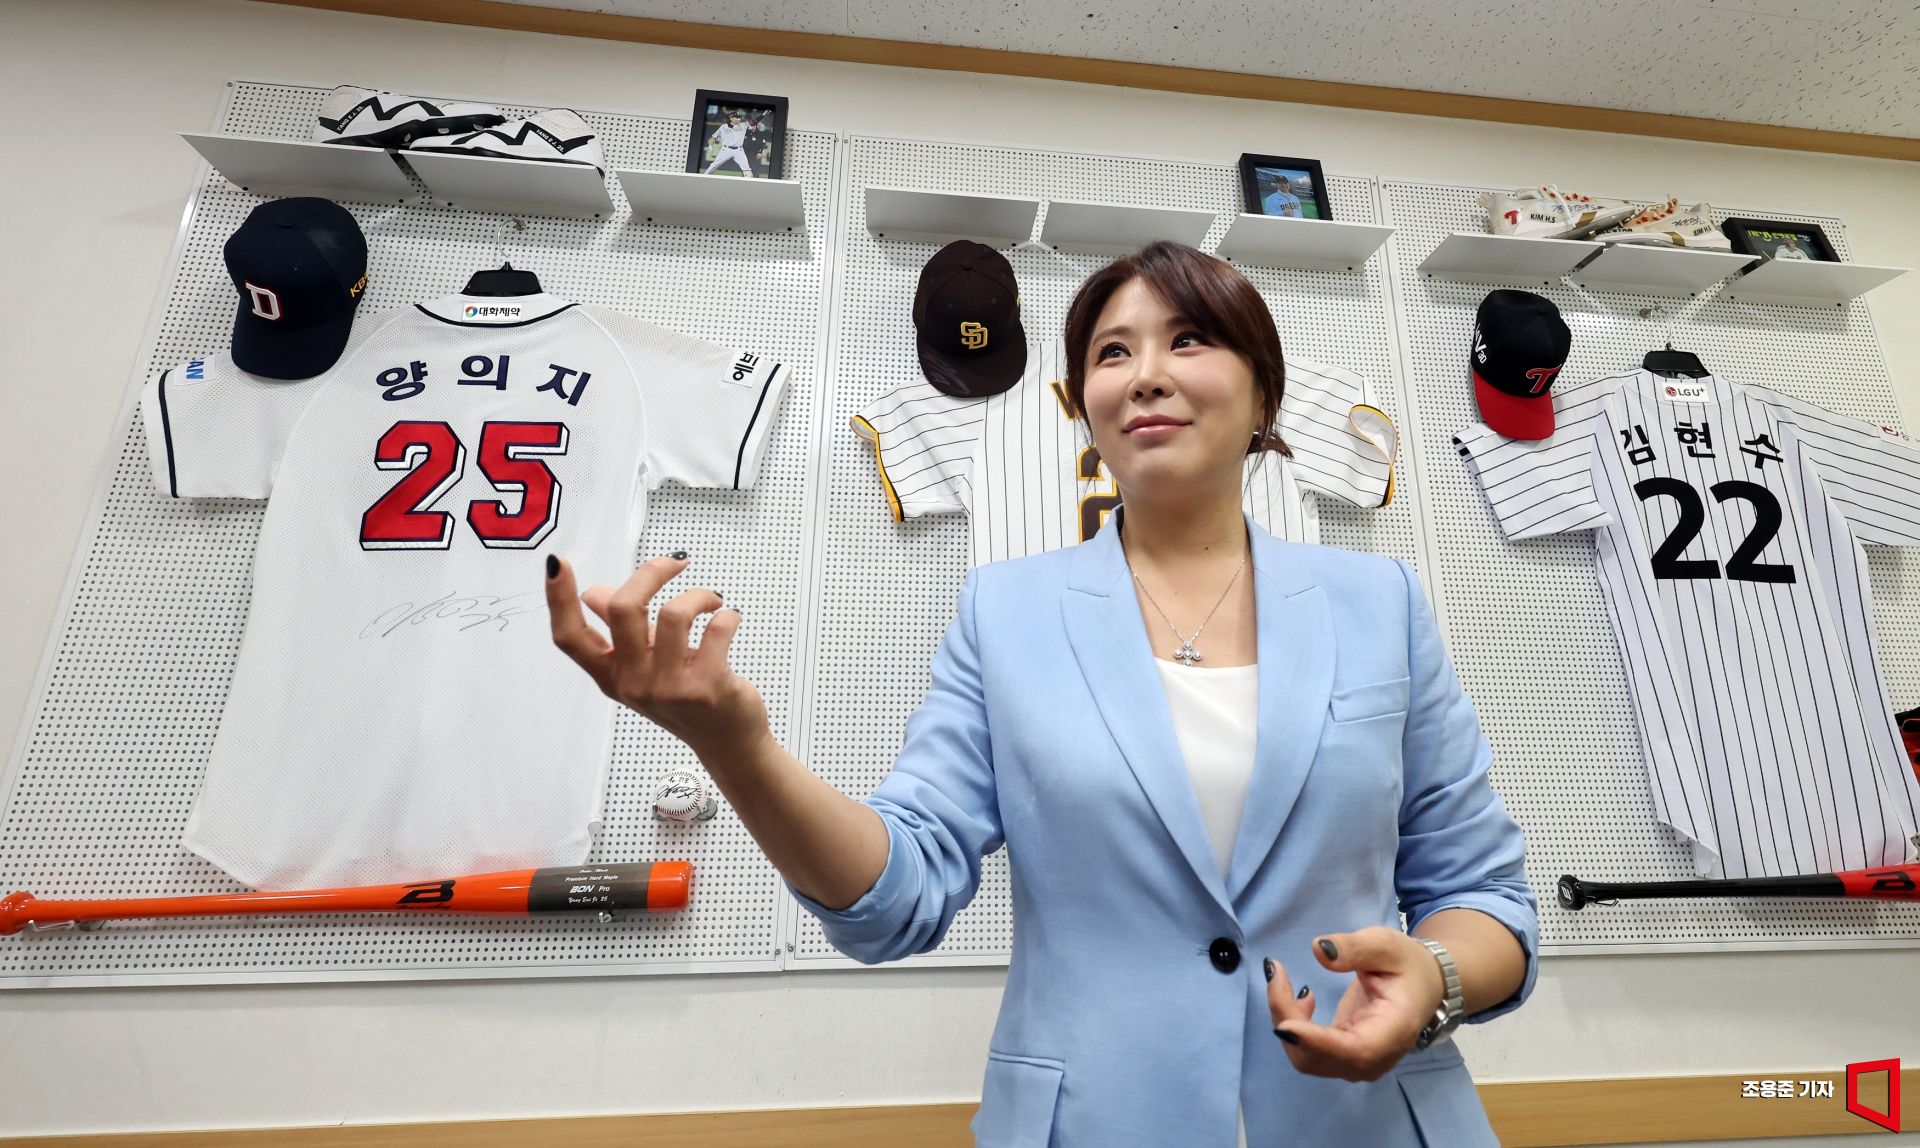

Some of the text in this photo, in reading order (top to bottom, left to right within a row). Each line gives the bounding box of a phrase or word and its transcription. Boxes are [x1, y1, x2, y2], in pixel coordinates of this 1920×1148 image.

[1530, 213, 1544, 221] KIM
[245, 280, 282, 321] D
[479, 306, 521, 317] 대화제약
[960, 321, 989, 350] SD
[1525, 363, 1562, 394] T
[1677, 387, 1691, 397] LG
[359, 420, 570, 551] 25
[1633, 476, 1797, 584] 22
